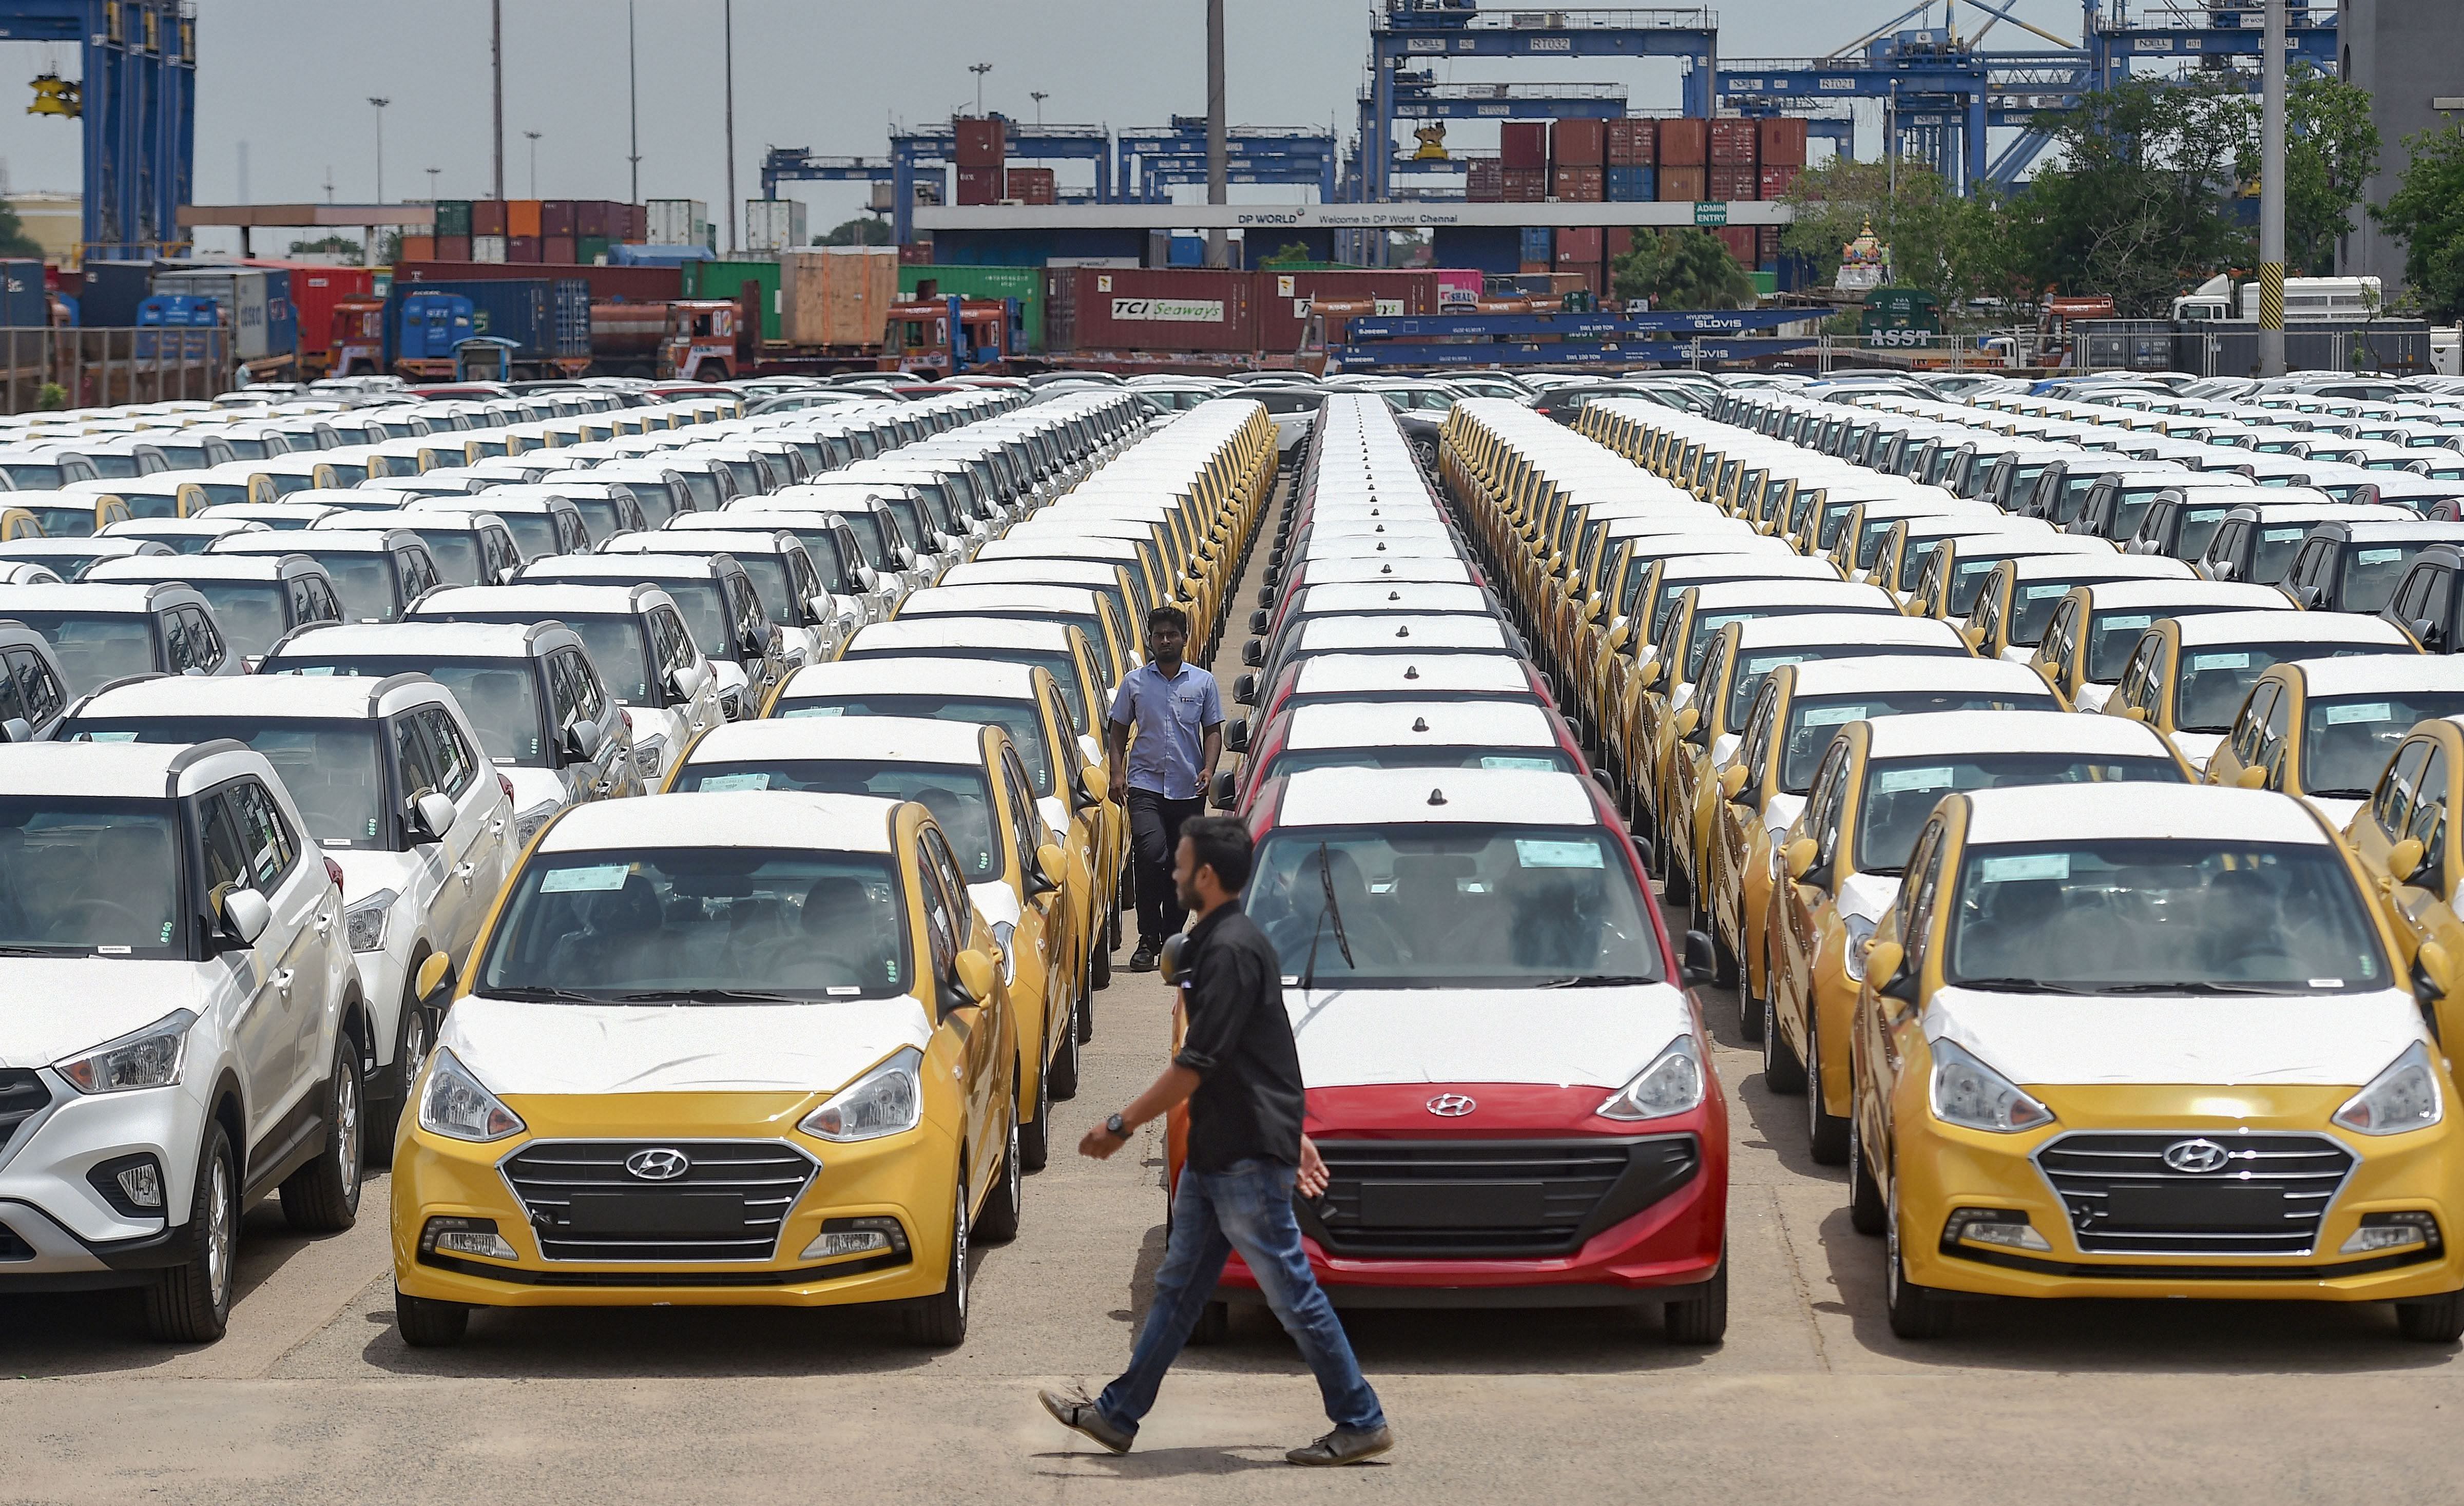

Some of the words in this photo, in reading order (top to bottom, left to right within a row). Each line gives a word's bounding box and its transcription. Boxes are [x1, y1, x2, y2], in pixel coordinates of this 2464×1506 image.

[1532, 40, 1568, 48] RT032
[1822, 80, 1853, 89] RT021
[1697, 204, 1726, 213] ADMIN
[1239, 215, 1253, 223] DP
[1256, 215, 1297, 223] WORLD
[1319, 215, 1359, 224] Welcome
[1362, 215, 1370, 223] to
[1374, 215, 1387, 223] DP
[1390, 215, 1415, 223] World
[1420, 215, 1458, 223] Chennai
[1697, 214, 1726, 222] ENTRY
[1114, 301, 1149, 314] TCI
[1154, 302, 1220, 319] Seaways
[1695, 319, 1742, 329] GLOVIS
[1871, 329, 1931, 346] ASST
